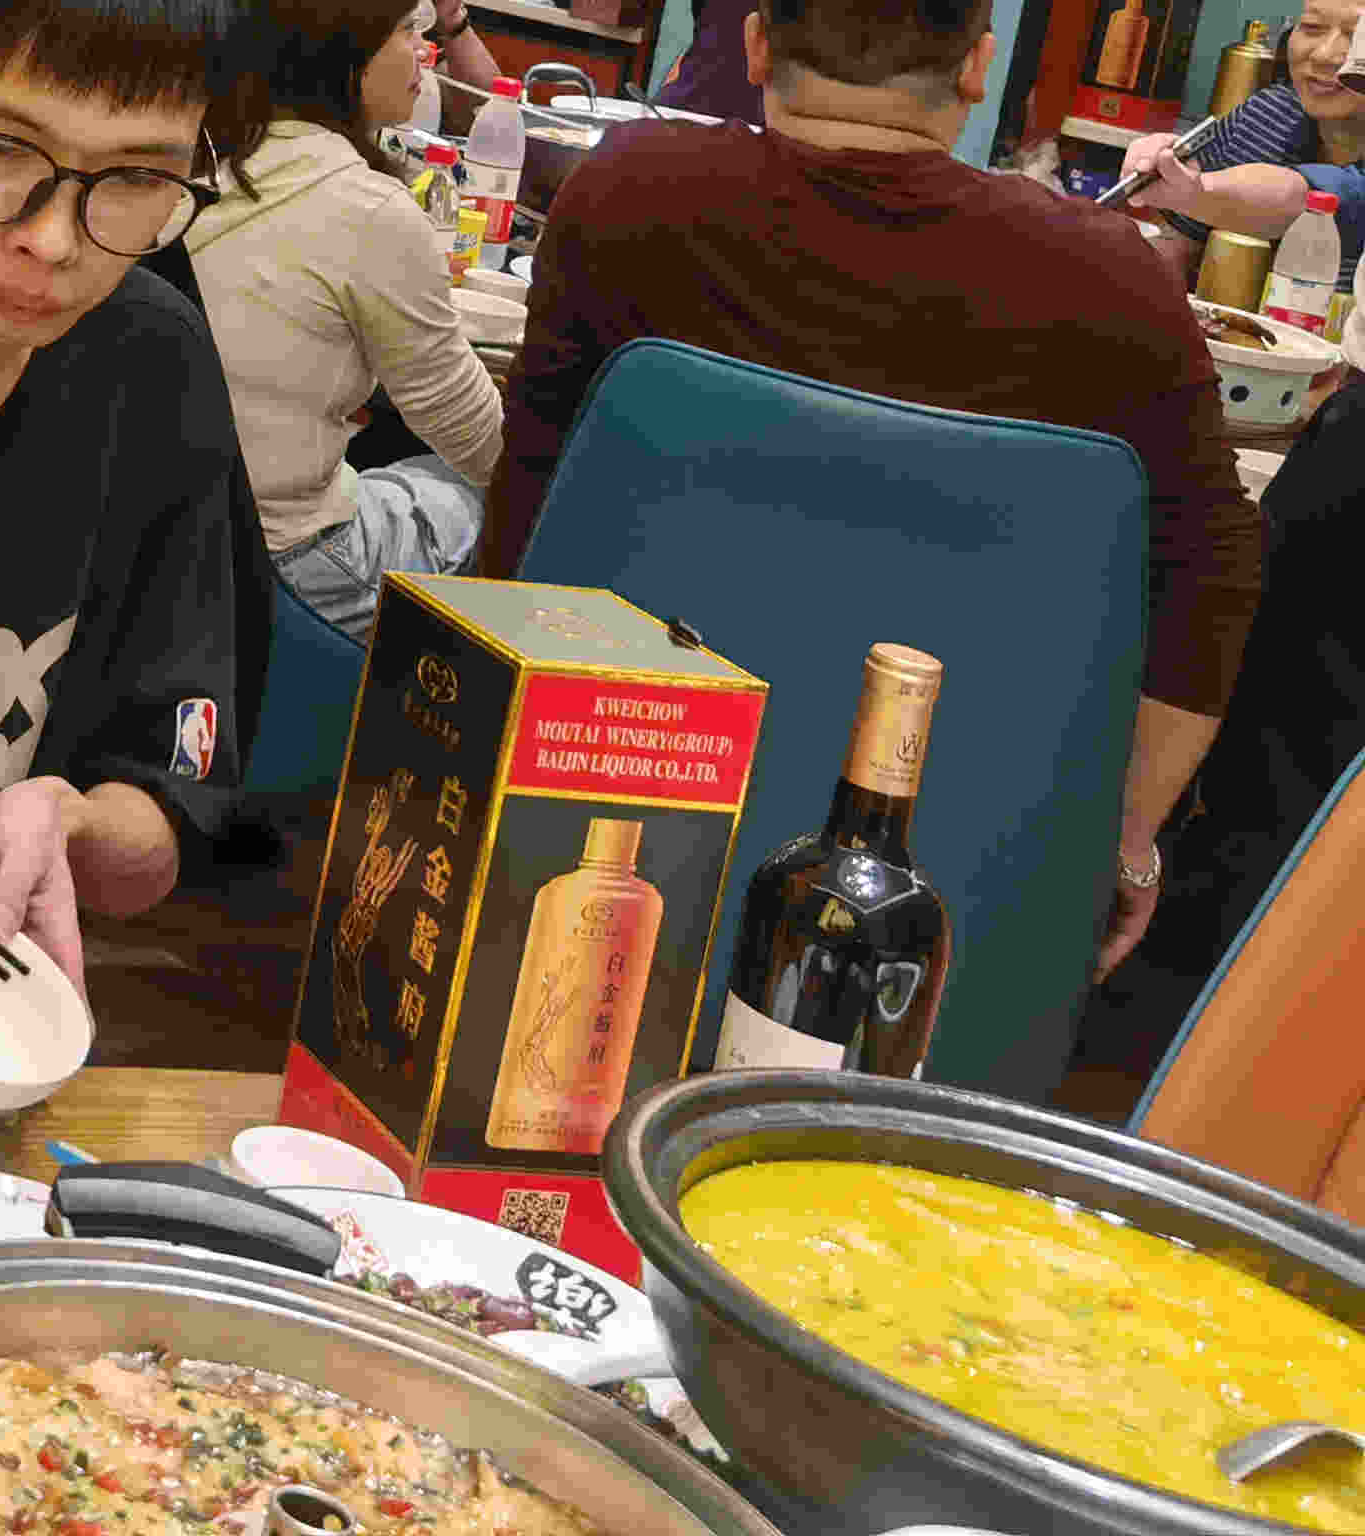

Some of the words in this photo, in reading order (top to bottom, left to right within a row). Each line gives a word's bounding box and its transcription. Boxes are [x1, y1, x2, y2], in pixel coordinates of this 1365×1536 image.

[593, 695, 688, 722] KWEICHOW
[534, 719, 602, 745] MOUTAI
[590, 751, 655, 779] LIQUOR
